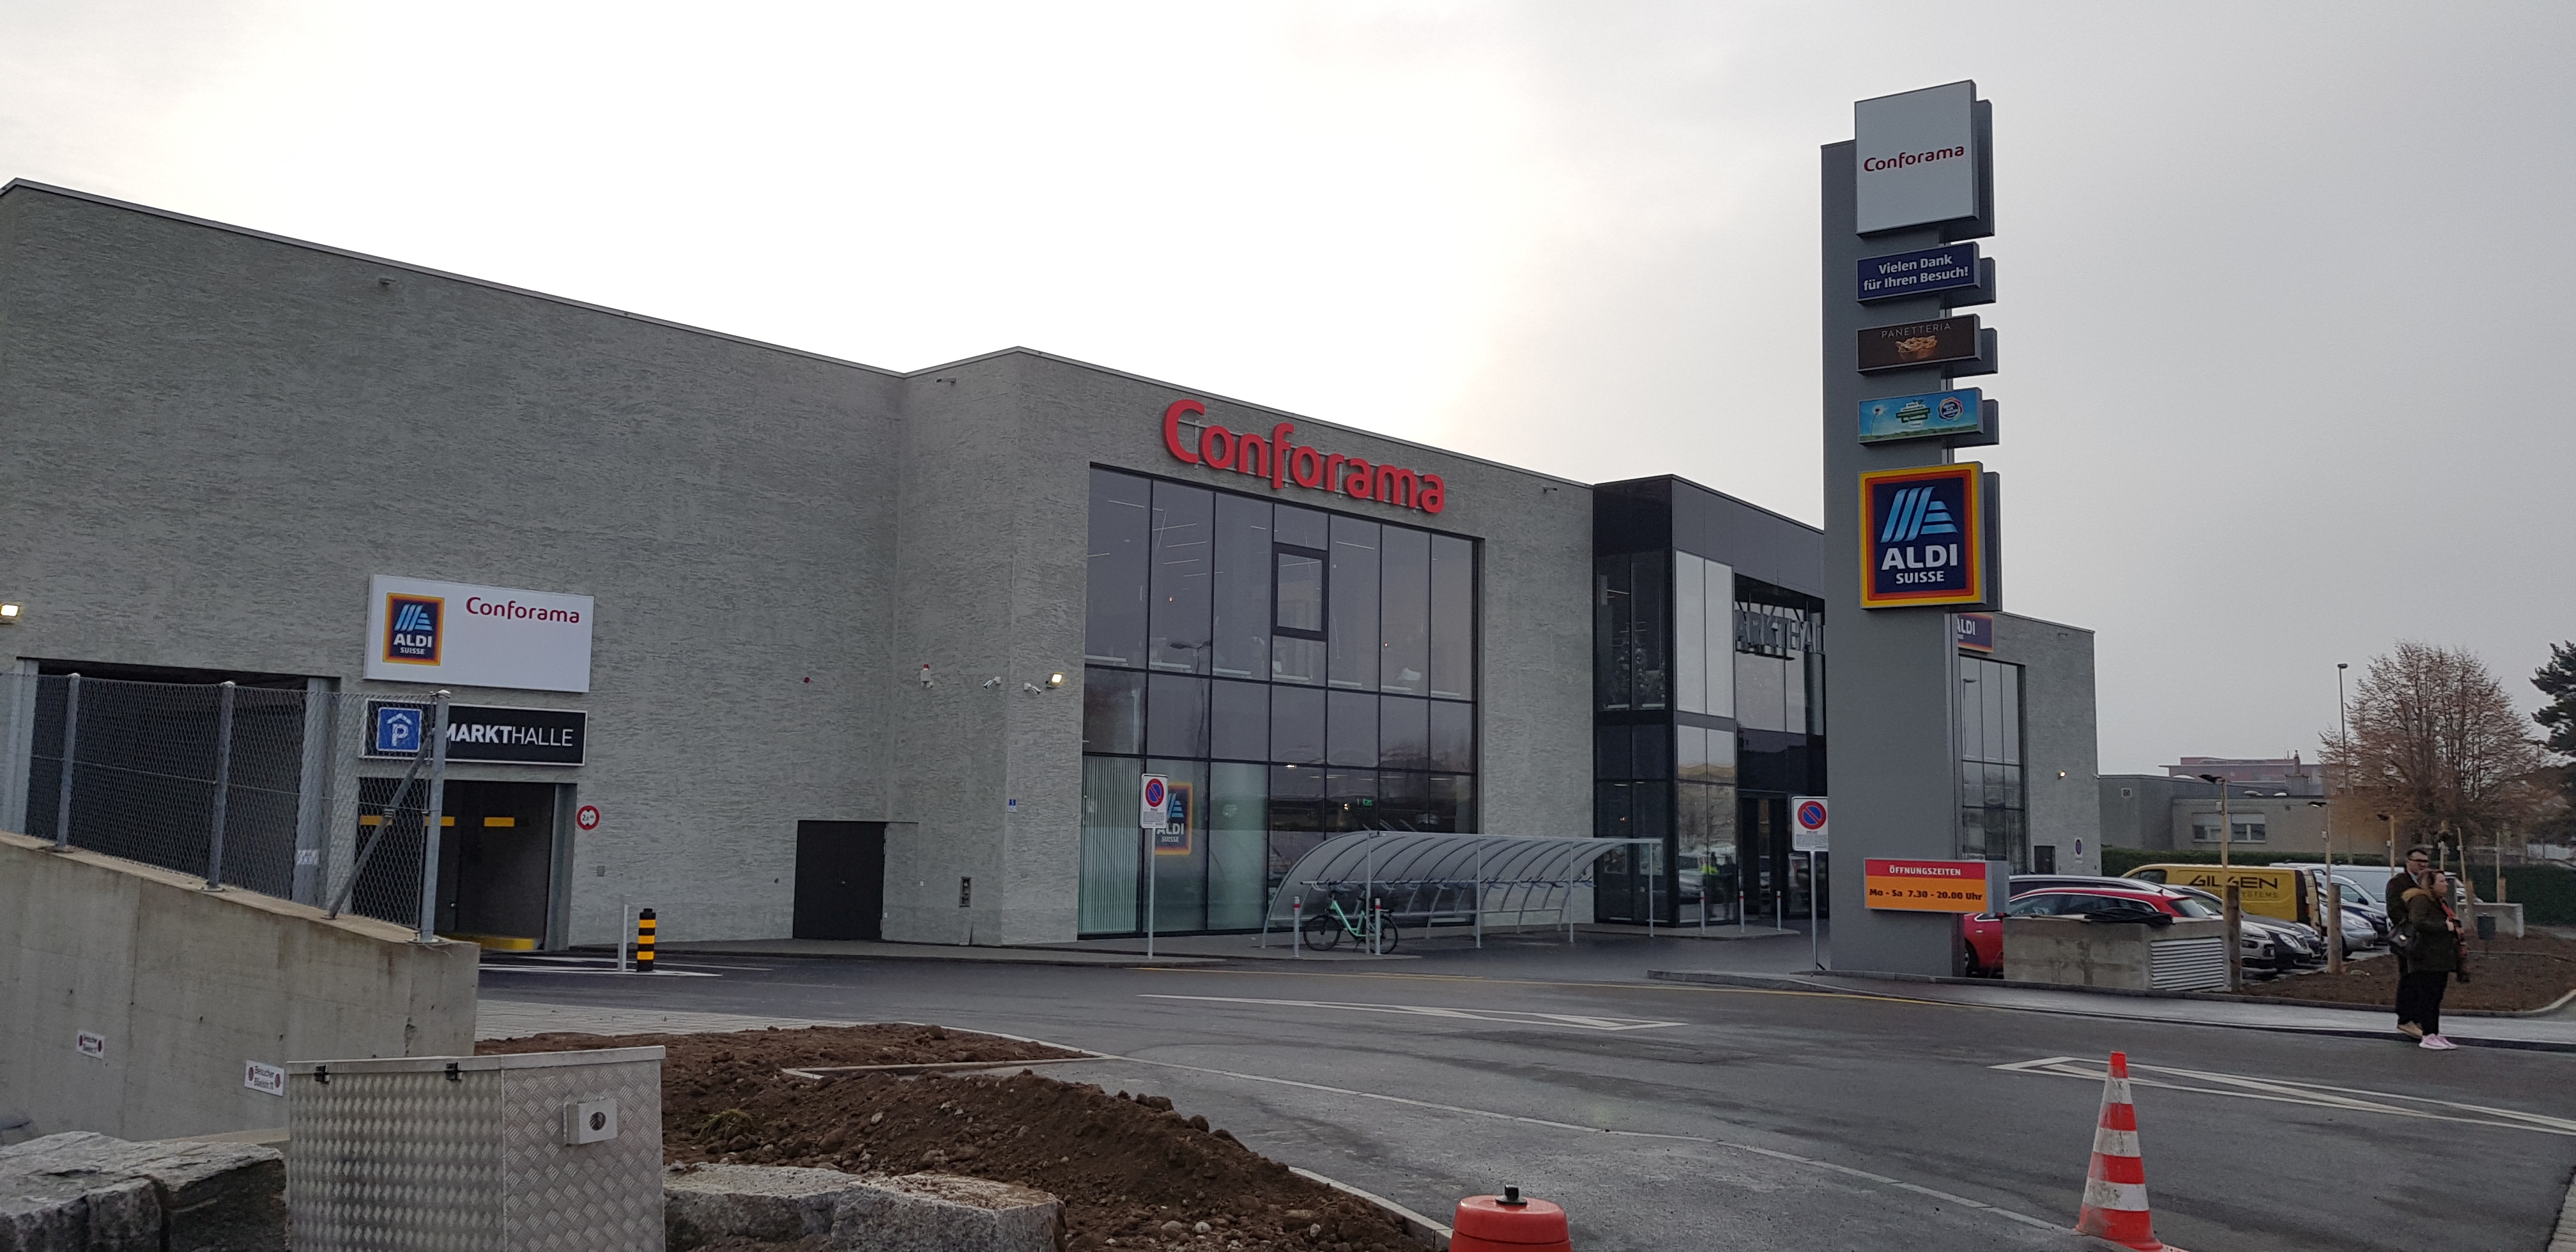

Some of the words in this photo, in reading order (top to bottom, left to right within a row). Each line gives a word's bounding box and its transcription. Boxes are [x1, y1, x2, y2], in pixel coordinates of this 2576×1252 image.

[1864, 146, 1965, 172] Conforama
[1878, 261, 1917, 275] Vielen
[1920, 254, 1952, 269] Dank
[1864, 280, 1882, 291] für
[1884, 275, 1917, 288] Ihren
[1920, 266, 1969, 283] Besuch!
[1881, 322, 1951, 339] PANETTERIA
[1163, 398, 1445, 514] Conforama
[1881, 544, 1958, 570] ALDI
[1896, 570, 1945, 584] SUISSE
[465, 596, 580, 624] Conforama
[393, 633, 433, 648] ALDI
[400, 647, 425, 655] SUISSE
[446, 722, 574, 747] MARKTHALLE
[1889, 864, 1961, 876] ÖFFNUNGSZEITEN
[1869, 889, 1883, 897] Mo
[1907, 890, 1928, 898] 7.30
[1936, 891, 1963, 900] 20.00
[1965, 892, 1982, 901] Uhr
